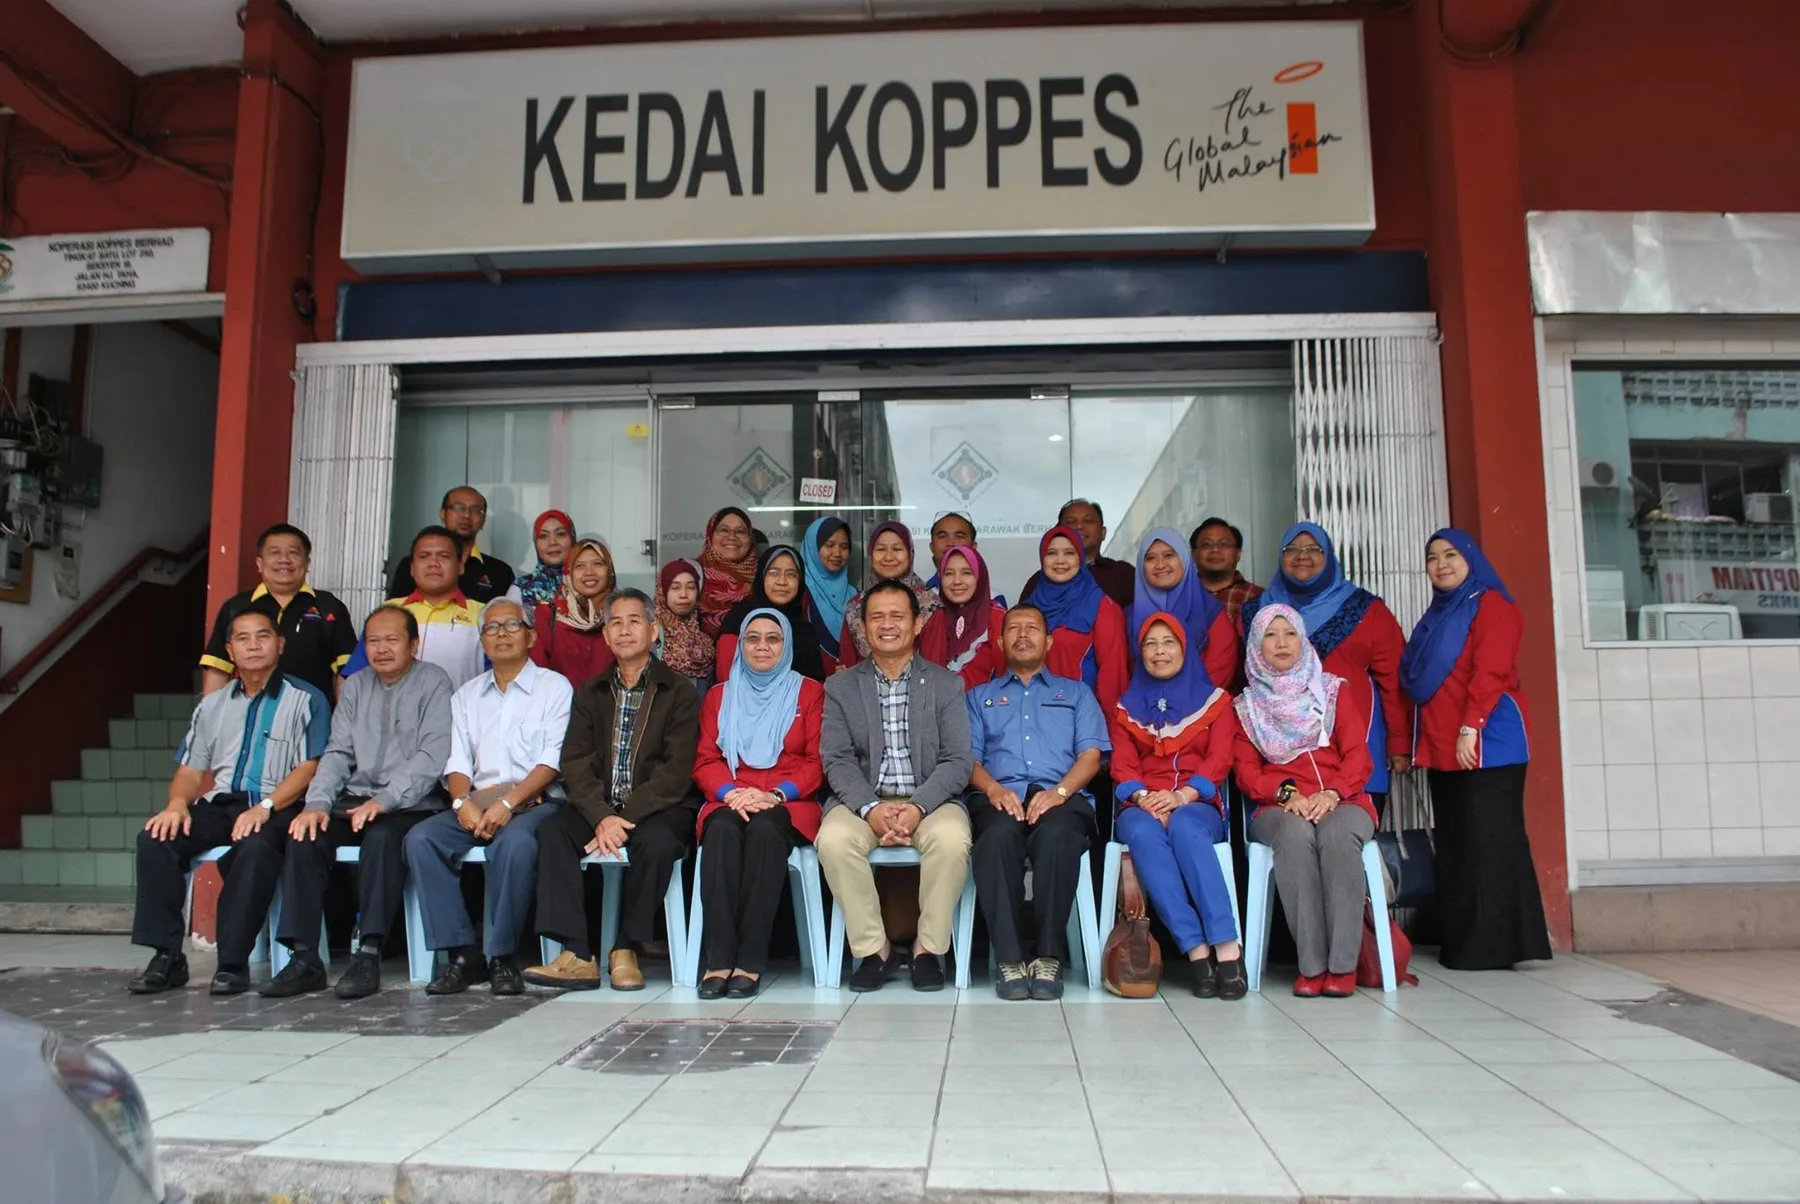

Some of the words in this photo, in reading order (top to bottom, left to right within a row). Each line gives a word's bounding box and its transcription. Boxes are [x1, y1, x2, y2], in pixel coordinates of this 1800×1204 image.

[1211, 85, 1275, 135] The
[522, 89, 766, 204] KEDAI
[814, 73, 1144, 194] KOPPES
[1164, 125, 1262, 183] Global
[1199, 131, 1343, 193] Malaysian
[802, 484, 834, 499] CLOSED
[662, 532, 704, 541] KOPERA
[976, 525, 1021, 534] ARAWAK
